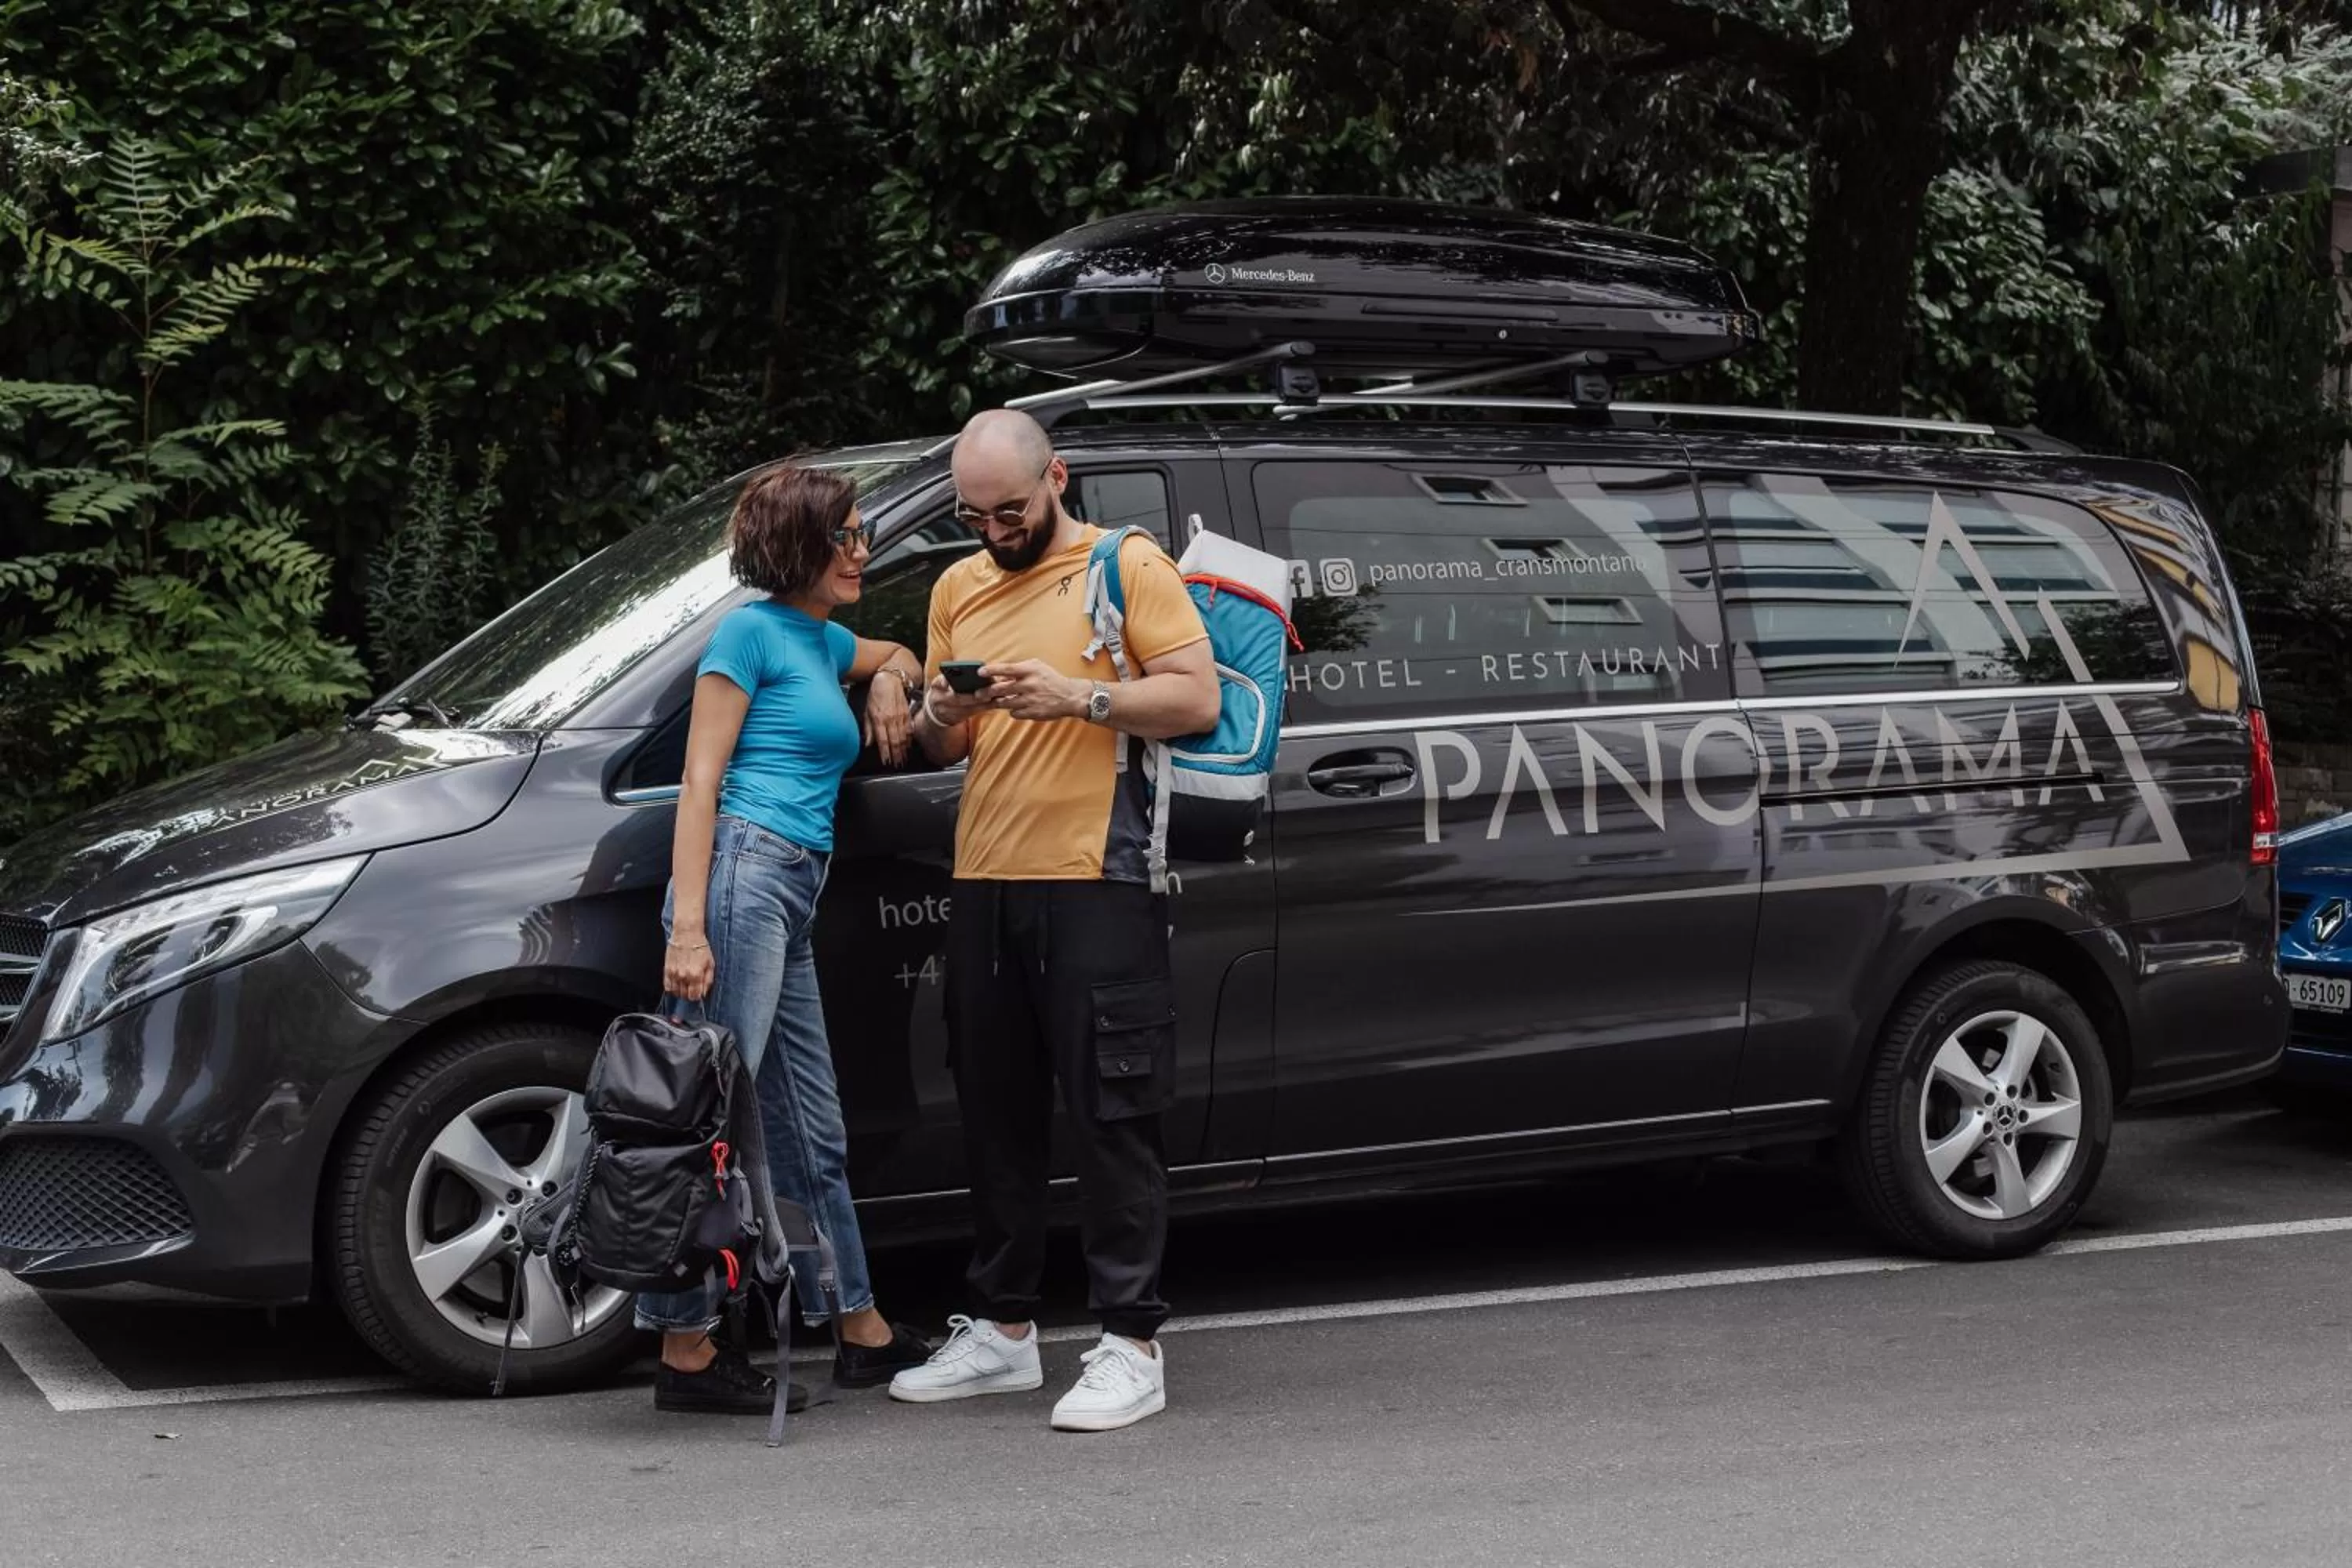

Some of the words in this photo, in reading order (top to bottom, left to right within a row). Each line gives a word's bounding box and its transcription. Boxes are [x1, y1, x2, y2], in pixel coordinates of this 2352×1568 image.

[1232, 267, 1316, 283] Mercedes-Benz
[1290, 658, 1422, 693] HOTEL
[1481, 644, 1720, 682] RESTAURANT
[1414, 699, 2105, 843] PANORAMA
[878, 895, 951, 929] hote
[894, 954, 946, 989] +4
[2300, 980, 2344, 1005] 65109
